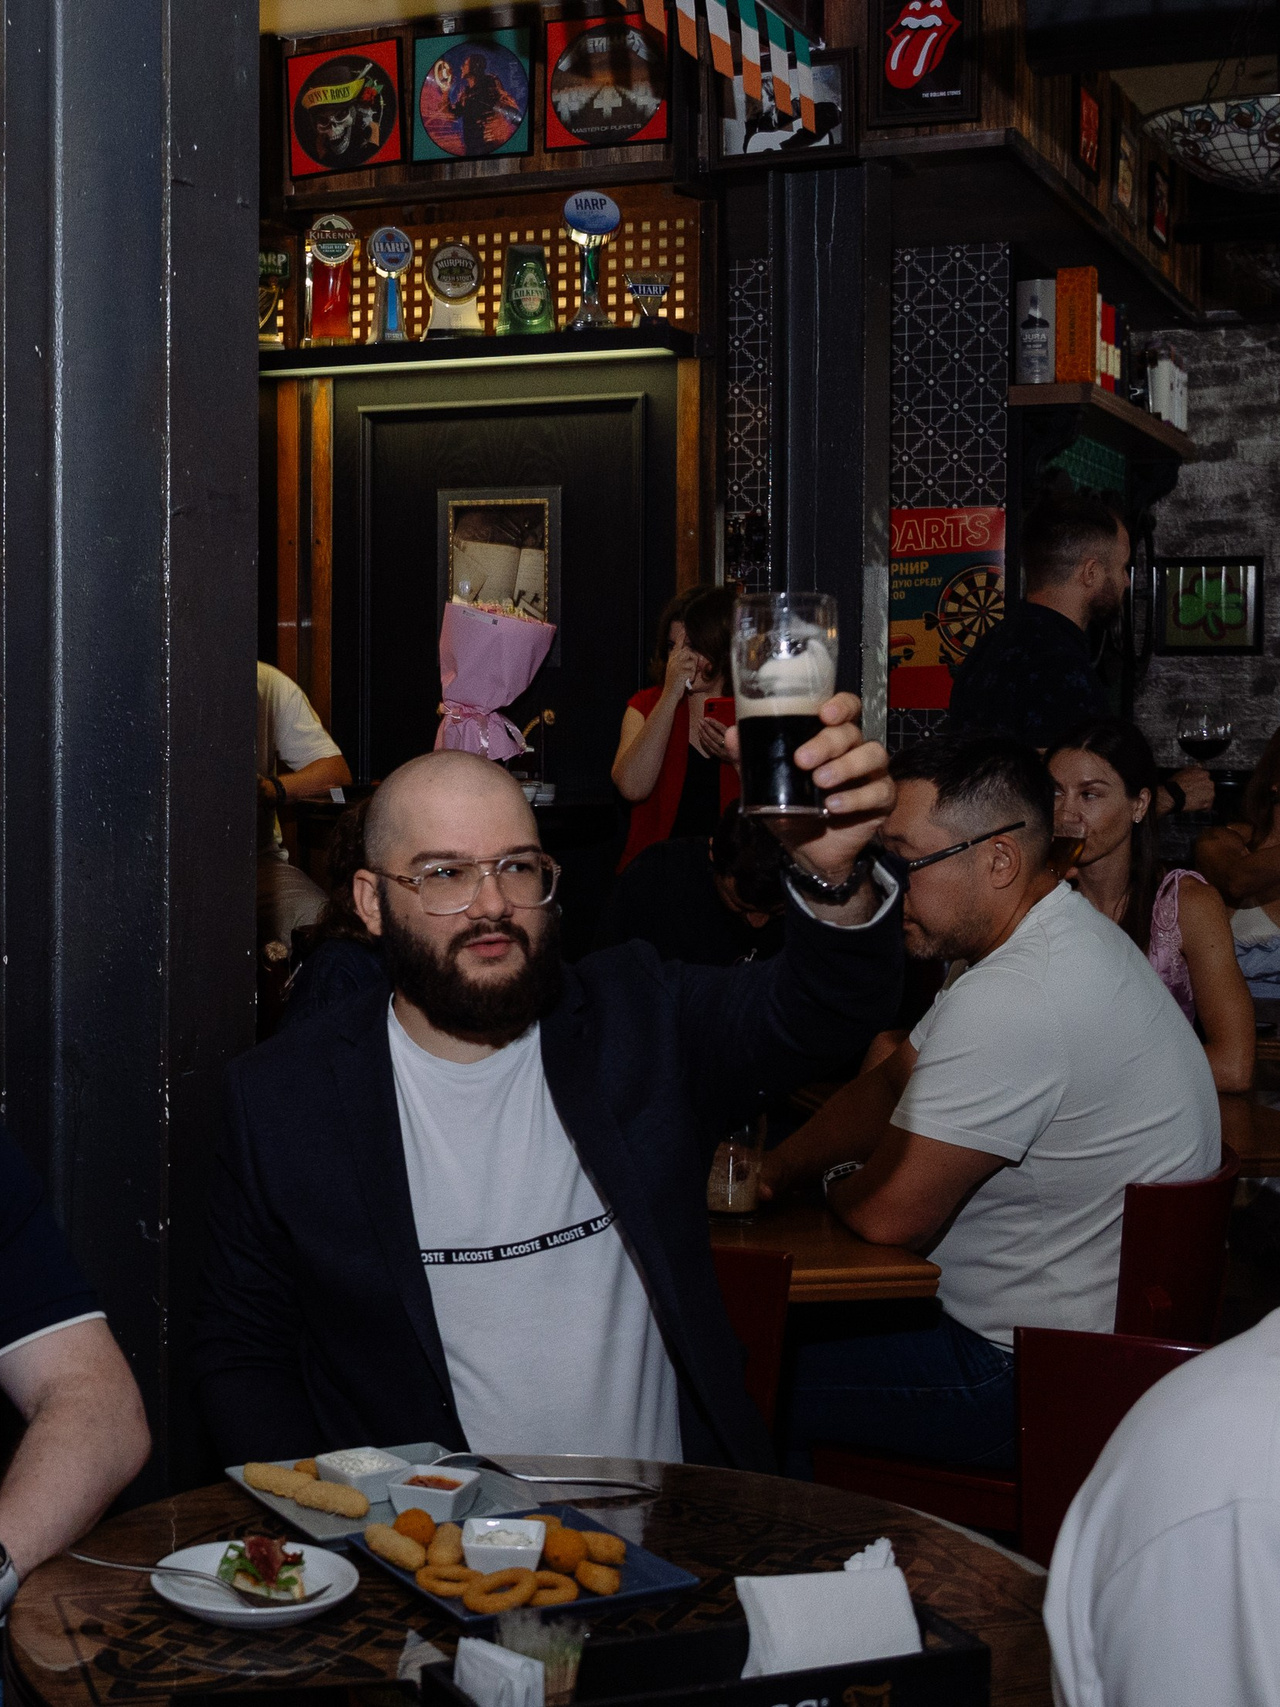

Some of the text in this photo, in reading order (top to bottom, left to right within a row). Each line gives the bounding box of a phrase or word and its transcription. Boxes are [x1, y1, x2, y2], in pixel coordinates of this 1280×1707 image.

[571, 123, 642, 134] MASTER OF PUPPETS
[574, 198, 607, 210] HARP
[309, 230, 357, 240] KILKENNY
[375, 241, 409, 253] HARP
[638, 285, 665, 295] HARP
[1022, 333, 1048, 341] JURA
[913, 576, 943, 587] СРЕДУ
[451, 1250, 494, 1263] LACOSTE
[500, 1239, 541, 1258] LACOSTE
[546, 1226, 586, 1247] LACOSTE
